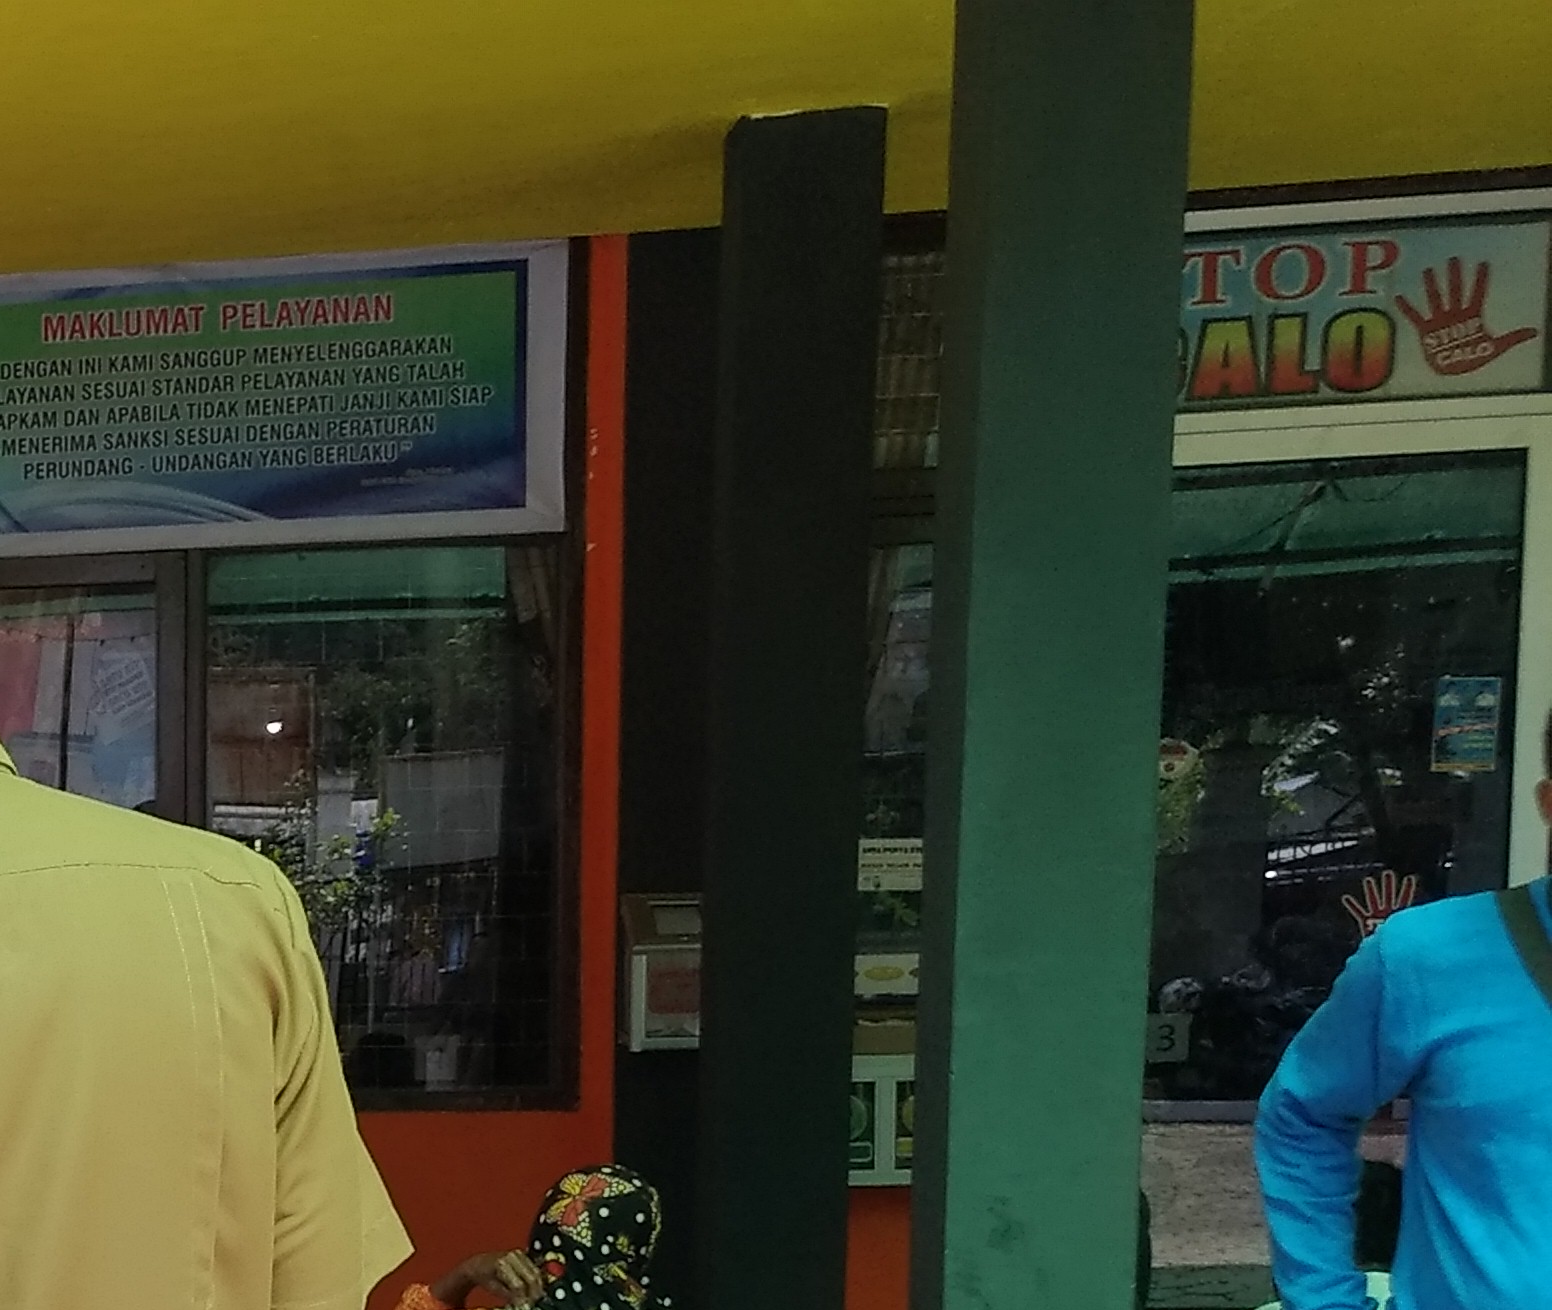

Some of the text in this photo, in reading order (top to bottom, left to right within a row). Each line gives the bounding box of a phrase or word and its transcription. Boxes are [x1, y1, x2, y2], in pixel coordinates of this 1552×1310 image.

[1184, 239, 1400, 306] TOP
[43, 294, 394, 343] MAKLUMAT PELAYANAN
[0, 357, 72, 380] DENGAN
[78, 355, 102, 376] INI
[108, 352, 153, 374] KAMI
[160, 348, 246, 371] SANGGUP
[254, 336, 453, 365] MENYELENGGARAKAN
[1176, 306, 1396, 400] ALO
[81, 379, 145, 401] SESUAI
[152, 375, 234, 398] STANDAR
[241, 367, 346, 391] PELAYANAN
[352, 364, 400, 384] YANG
[407, 361, 465, 381] TALAH
[64, 407, 100, 428] DAN
[106, 403, 181, 425] APABILA
[186, 400, 239, 421] TIDAK
[245, 393, 334, 417] MENEPATI
[340, 390, 391, 412] JANJI
[396, 387, 443, 409] KAMI
[449, 385, 493, 406] SIAP
[1, 415, 436, 457] MENERIMA SANKSI SESUAI DENGAN PERATURAN
[23, 457, 133, 481] PERUNDANG
[152, 451, 252, 475] UNDANGAN
[258, 447, 307, 469] YANG
[1156, 1024, 1176, 1051] 3
